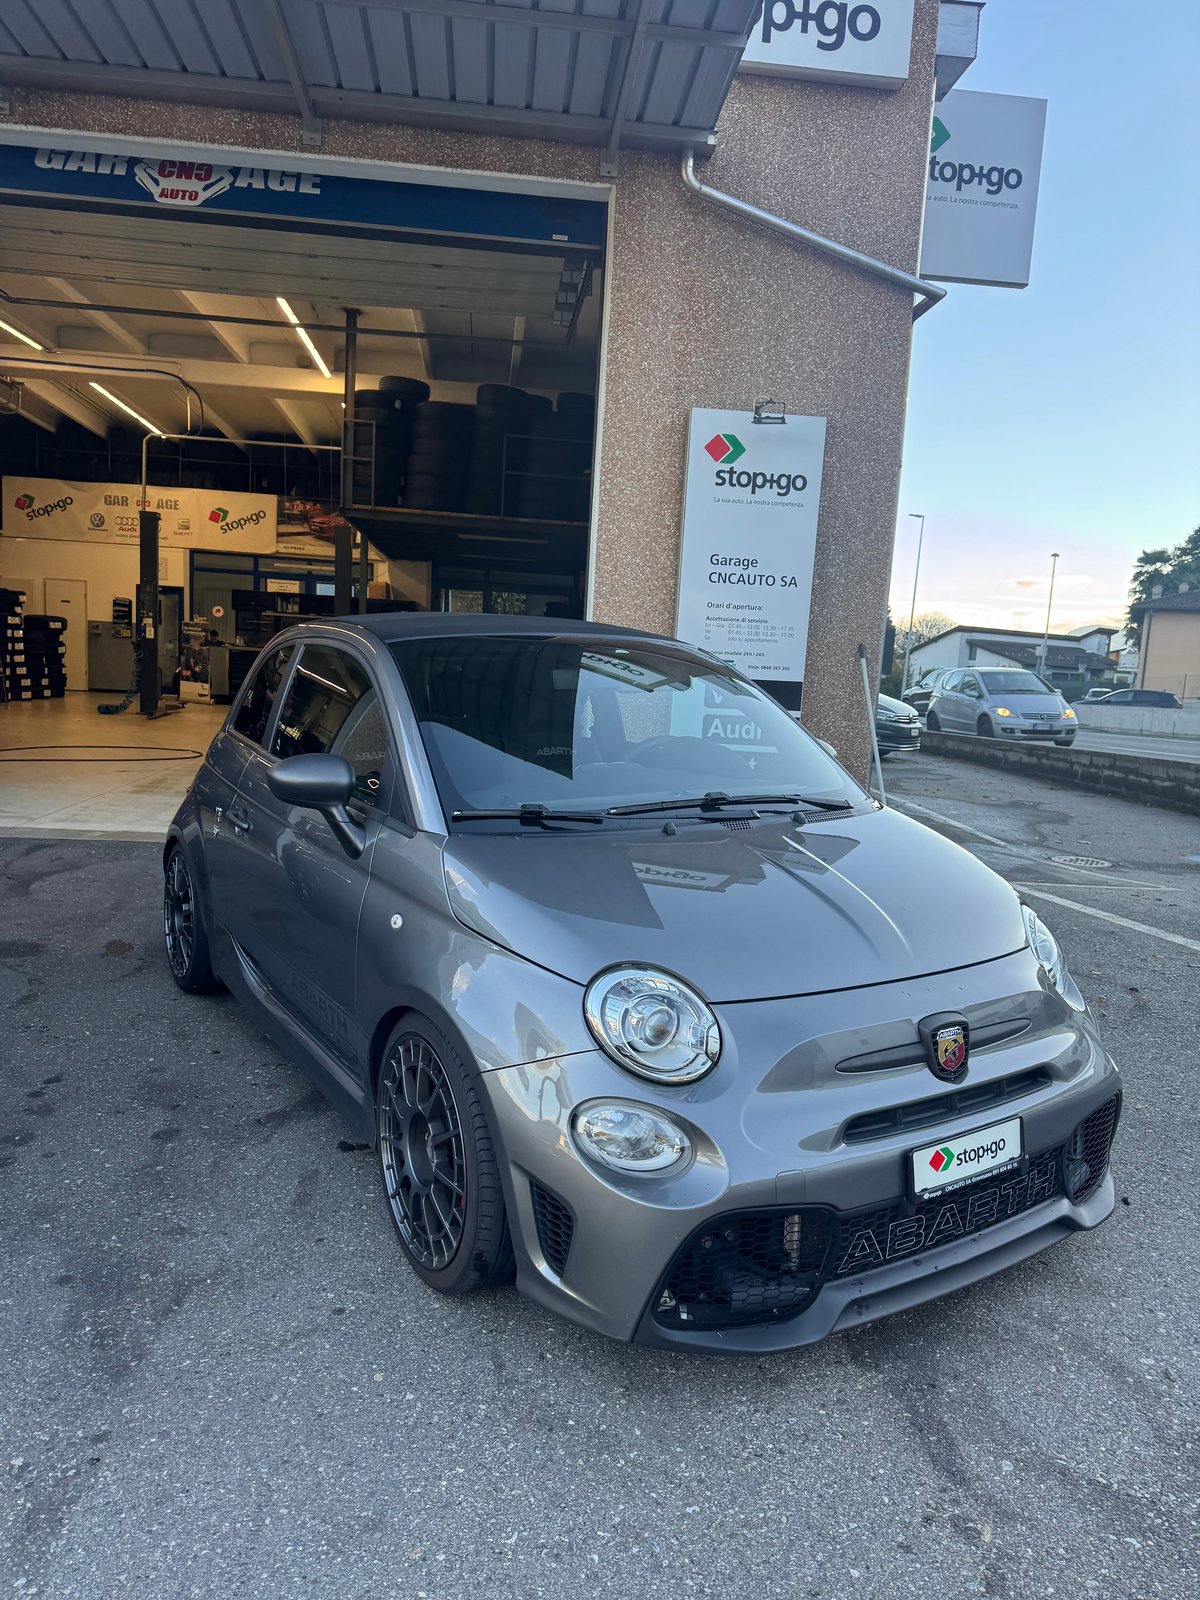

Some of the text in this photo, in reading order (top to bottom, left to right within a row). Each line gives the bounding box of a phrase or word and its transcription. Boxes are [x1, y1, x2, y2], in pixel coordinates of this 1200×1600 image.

[754, 0, 881, 50] p+go
[34, 148, 127, 176] GAR
[234, 168, 321, 194] AGE
[929, 155, 1022, 195] top+go
[158, 187, 199, 201] AUTO
[715, 466, 807, 496] stop+go
[26, 496, 74, 521] stop+go
[104, 494, 128, 507] GAR
[157, 498, 179, 511] AGE
[220, 509, 266, 534] stop+go
[710, 553, 758, 570] Garage
[708, 571, 798, 587] CNCAUTO SA
[726, 603, 763, 611] d'apertura:
[956, 1138, 1005, 1166] stop+go
[838, 1161, 1056, 1273] ABARTH
